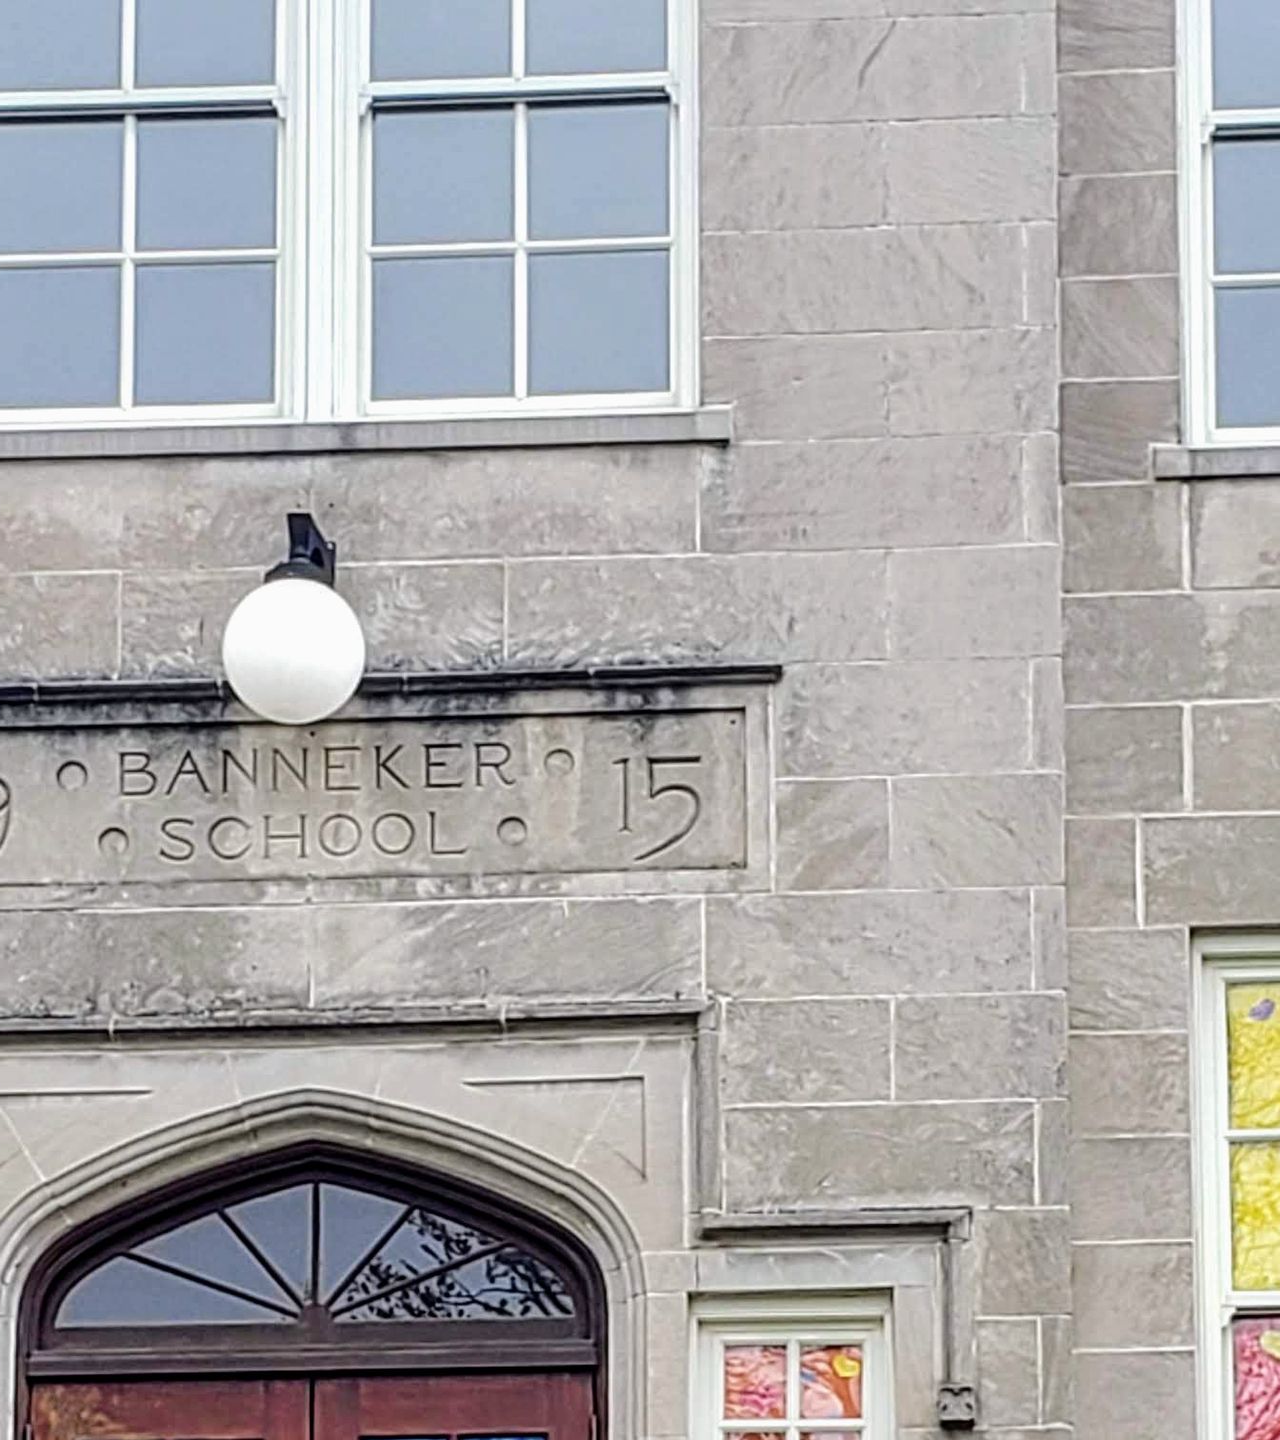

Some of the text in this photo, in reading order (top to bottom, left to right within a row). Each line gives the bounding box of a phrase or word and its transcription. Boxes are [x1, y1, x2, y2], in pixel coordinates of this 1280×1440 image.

[118, 741, 516, 796] BANNEKER
[612, 755, 702, 861] 15
[159, 811, 468, 862] SCHOOL
